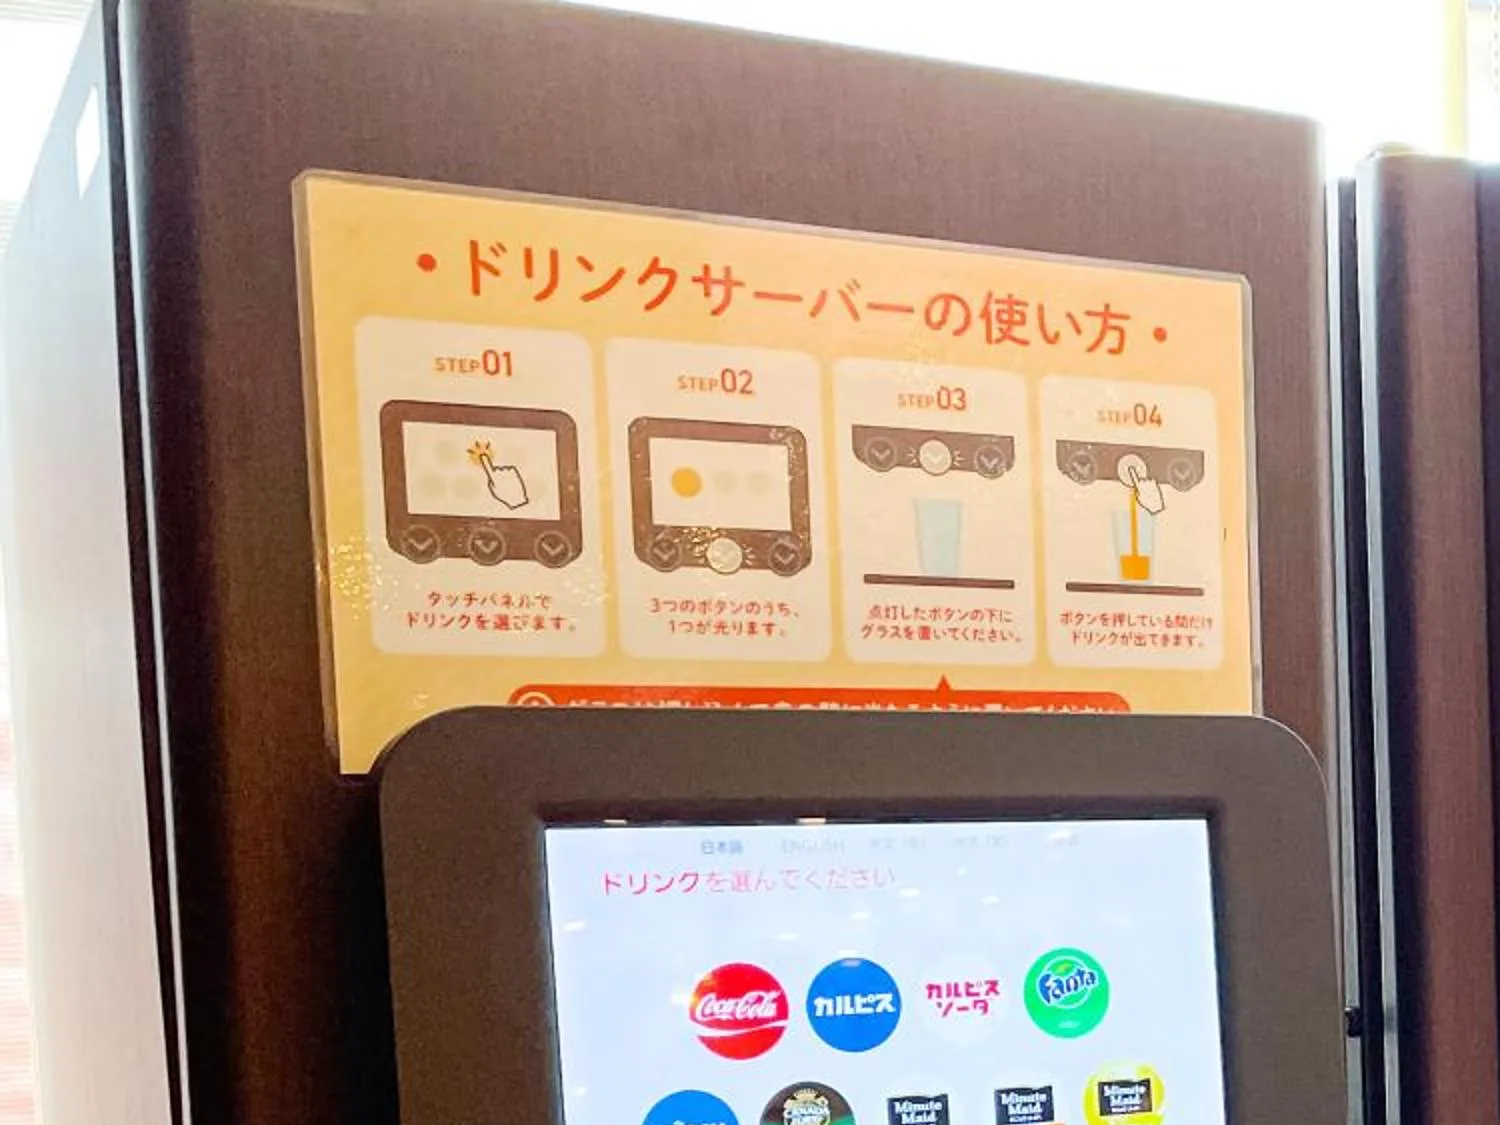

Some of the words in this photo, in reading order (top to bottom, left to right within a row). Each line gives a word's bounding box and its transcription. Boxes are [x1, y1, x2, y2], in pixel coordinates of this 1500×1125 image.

[465, 238, 1131, 356] ドリンクサーバーの使い方
[427, 591, 552, 610] タッチパネルで
[867, 604, 1014, 625] 点灯したボタンの下に
[1059, 611, 1214, 631] ボタンを押している間だけ
[860, 624, 1023, 644] グラスを置いてください。
[701, 840, 744, 855] 日本語
[602, 866, 895, 896] ドリンクを選んでください
[925, 978, 1000, 999] カルピス
[1037, 968, 1097, 1006] Fanta
[814, 991, 897, 1018] カルピス
[935, 998, 990, 1017] ソーダ
[1001, 1092, 1048, 1106] Minute
[1103, 1084, 1146, 1097] Minute
[894, 1101, 943, 1115] Minute
[1007, 1103, 1043, 1116] Maid
[1110, 1094, 1142, 1107] Maid
[901, 1112, 937, 1125] Maid
